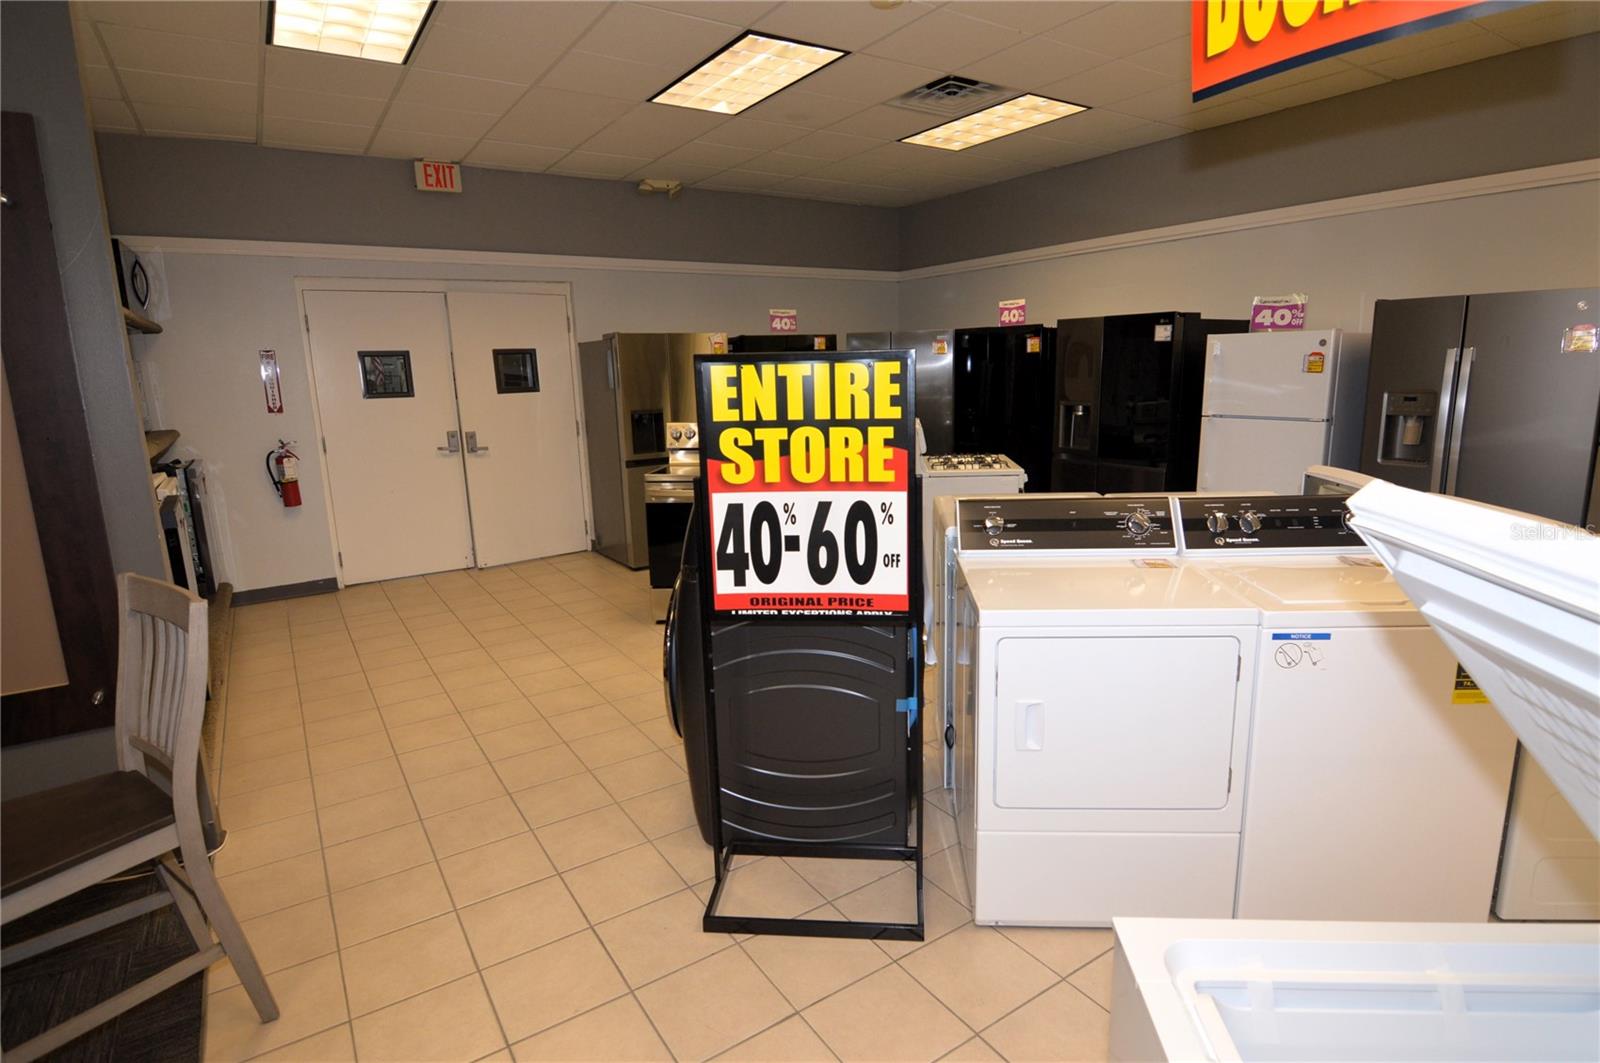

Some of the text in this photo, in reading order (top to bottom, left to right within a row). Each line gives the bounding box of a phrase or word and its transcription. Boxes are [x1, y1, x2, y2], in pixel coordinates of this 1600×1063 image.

[423, 163, 455, 189] EXIT
[710, 361, 902, 422] ENTIRE
[719, 425, 896, 485] STORE
[883, 553, 901, 568] OFF
[750, 597, 874, 608] ORIGINAL PRICE
